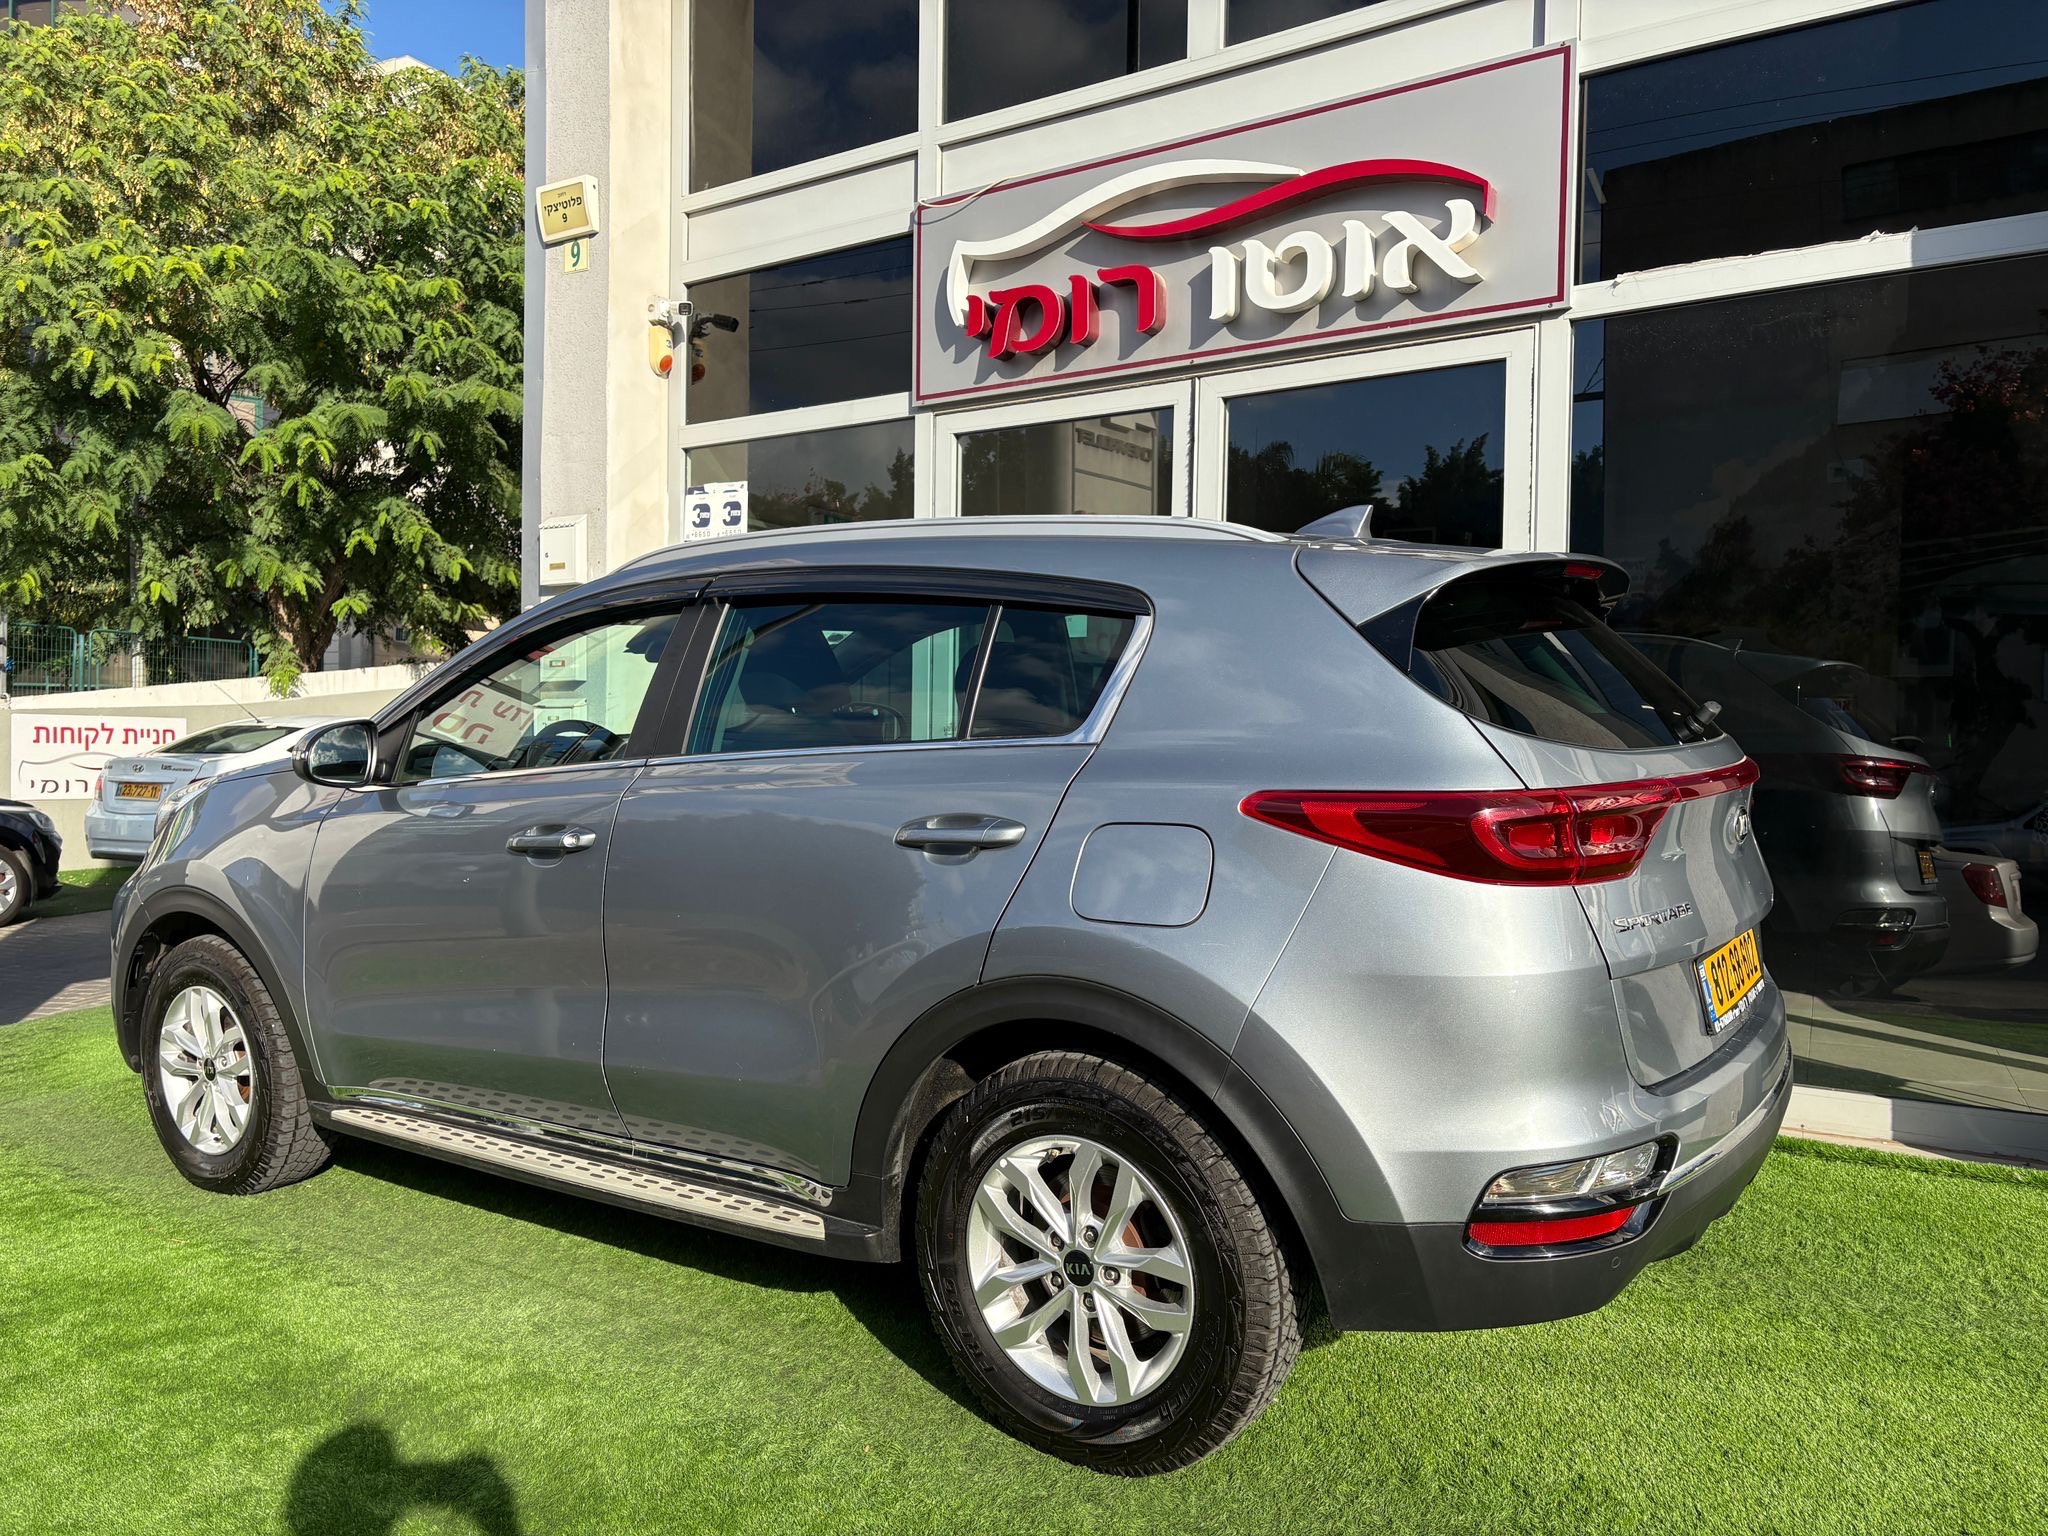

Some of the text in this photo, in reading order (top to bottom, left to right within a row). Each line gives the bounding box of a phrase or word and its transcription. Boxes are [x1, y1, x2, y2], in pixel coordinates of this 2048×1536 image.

[543, 196, 582, 216] פלוטיצקי
[562, 212, 568, 222] 9
[570, 239, 581, 268] 9
[966, 198, 1485, 360] אוטו רומי
[32, 722, 176, 751] חניית לקוחות
[30, 778, 89, 794] רומי
[1065, 1262, 1091, 1277] KIA
